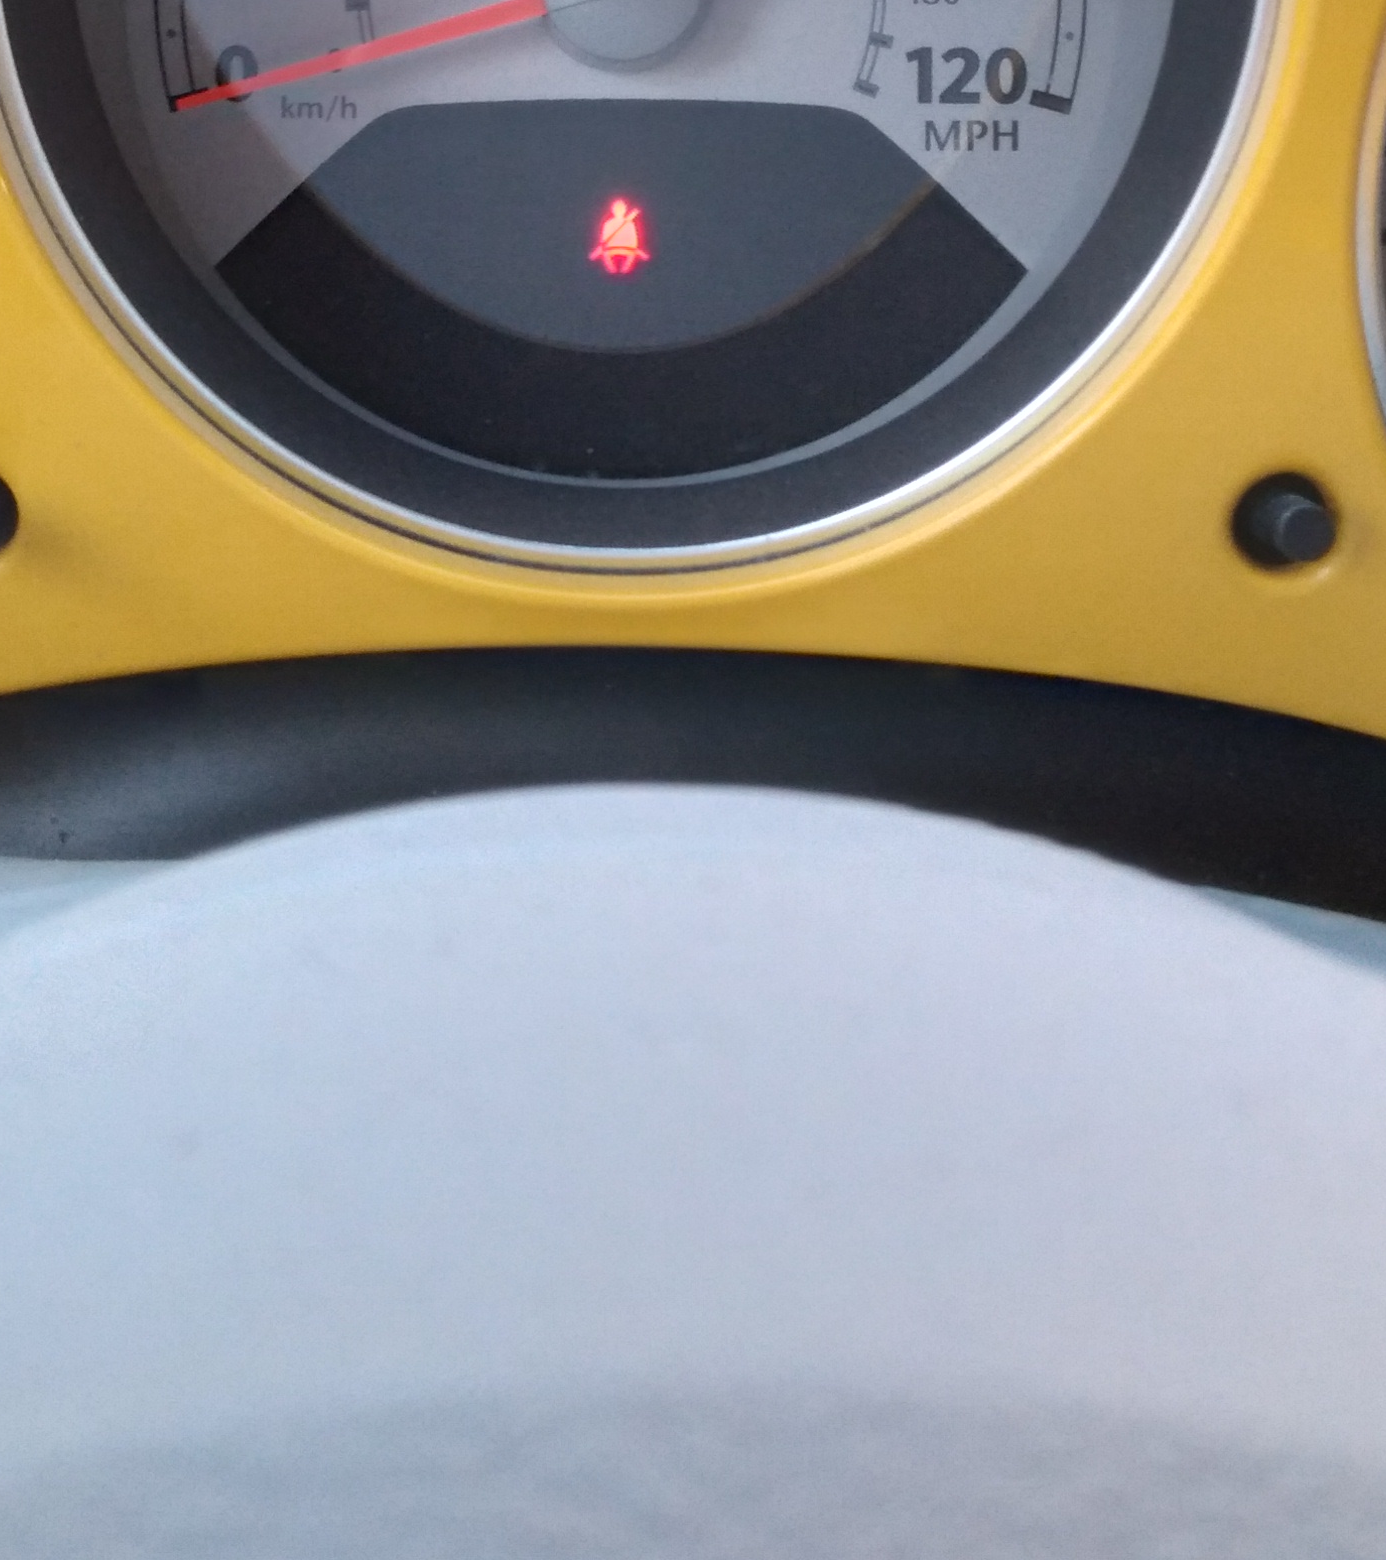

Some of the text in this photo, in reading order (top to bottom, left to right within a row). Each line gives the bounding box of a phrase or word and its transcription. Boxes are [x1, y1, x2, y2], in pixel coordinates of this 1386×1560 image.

[214, 44, 259, 103] 0
[905, 46, 1028, 104] 120
[280, 94, 358, 122] km/h
[923, 119, 1019, 151] MPH
